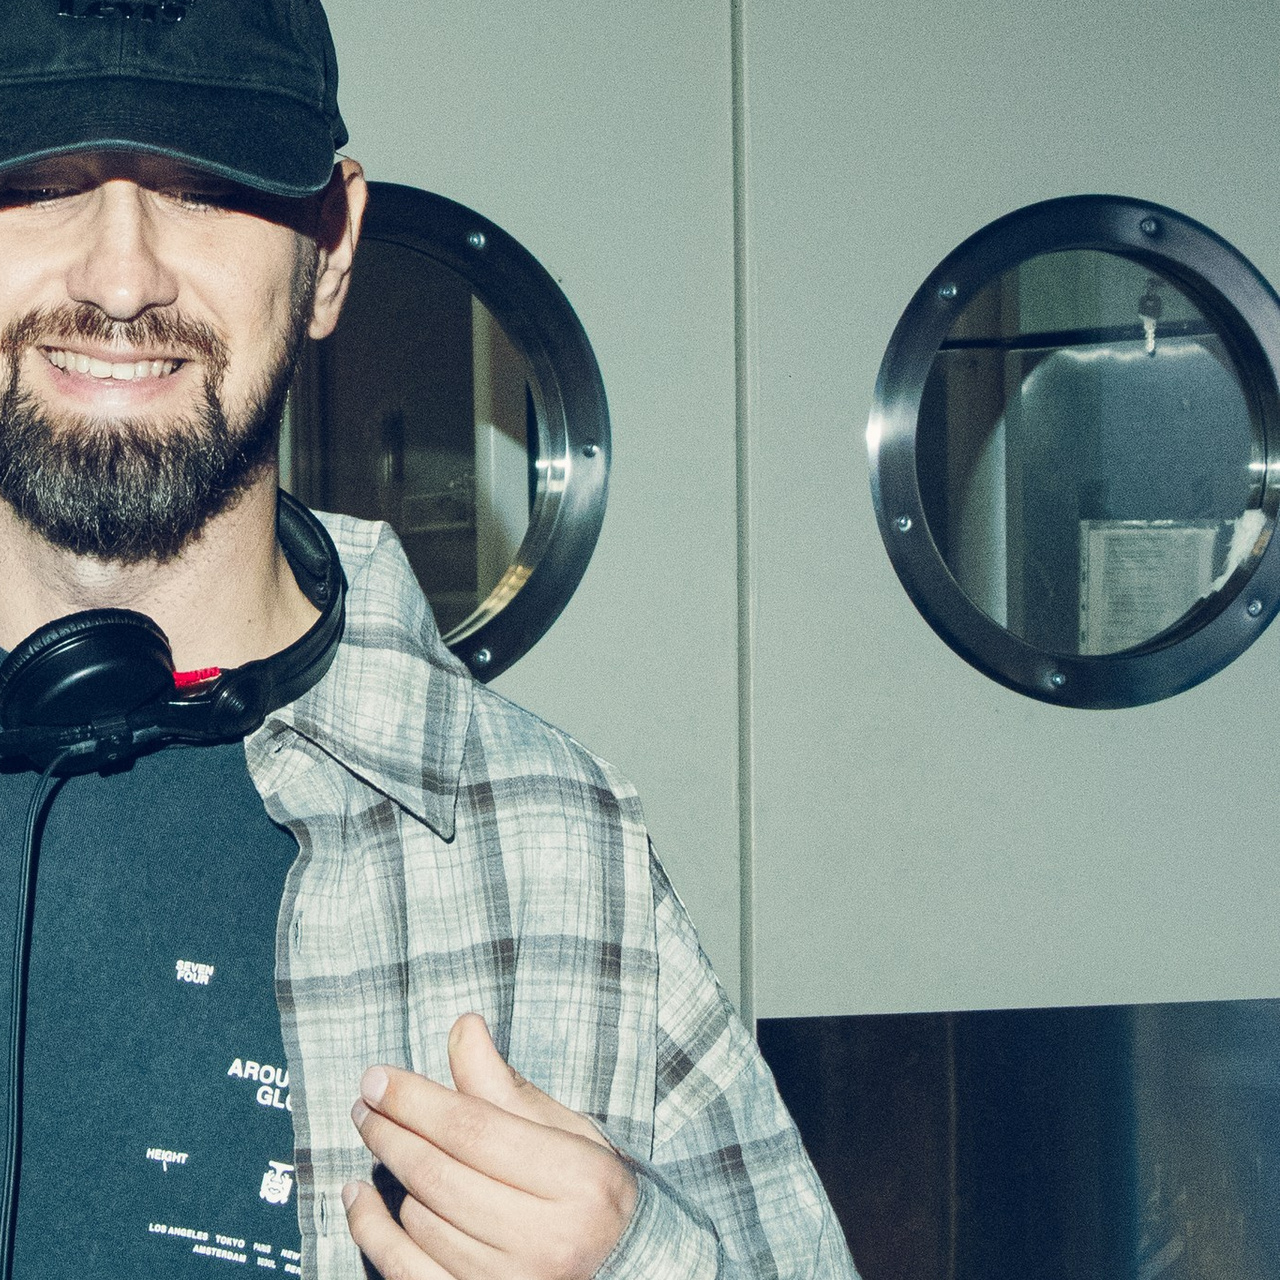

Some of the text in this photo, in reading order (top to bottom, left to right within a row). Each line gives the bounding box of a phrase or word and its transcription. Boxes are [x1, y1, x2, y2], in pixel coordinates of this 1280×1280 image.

[175, 959, 215, 977] SEVEN
[176, 969, 210, 986] FOUR
[227, 1057, 290, 1088] AROU
[146, 1147, 189, 1164] HEIGHT
[148, 1222, 301, 1262] LOS ANGELES TOKYO PARIS NEW
[192, 1244, 248, 1264] AMSTERDAM
